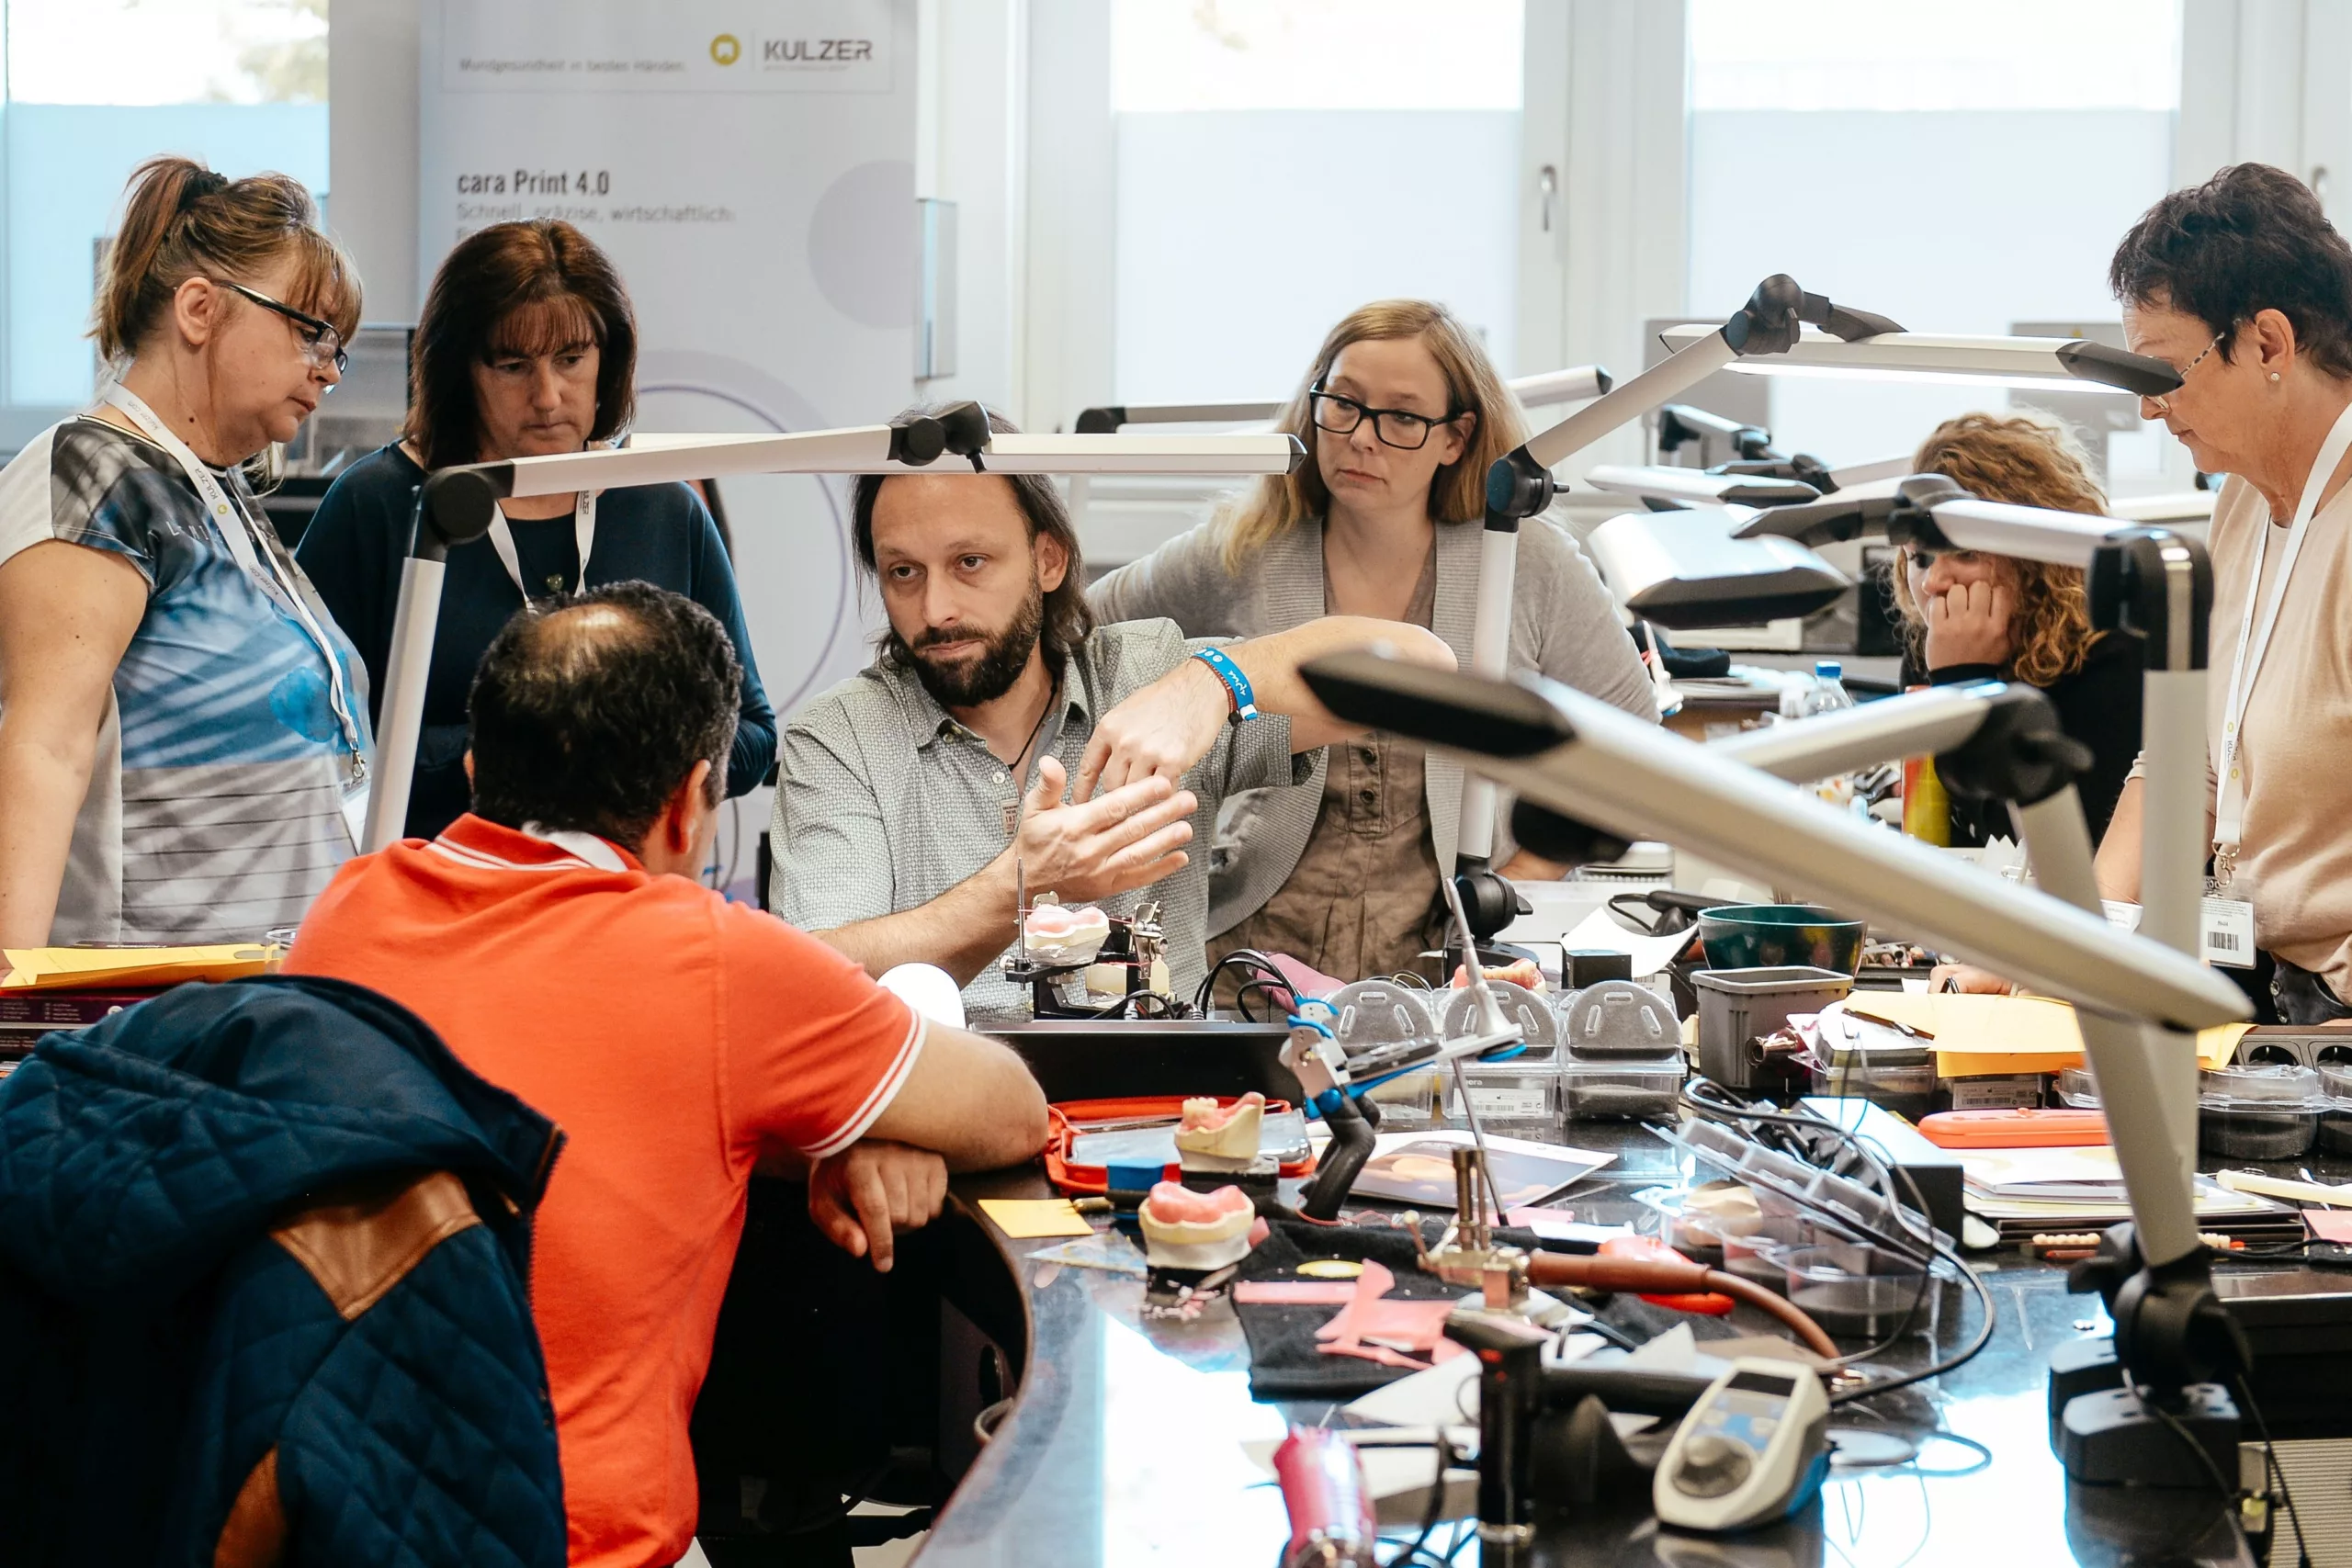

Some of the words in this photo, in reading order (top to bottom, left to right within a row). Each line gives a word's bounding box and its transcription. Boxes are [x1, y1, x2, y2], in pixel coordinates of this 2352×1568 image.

[763, 39, 873, 61] KULZER
[458, 173, 506, 195] cara
[514, 169, 567, 195] Print
[576, 171, 610, 195] 4.0
[194, 468, 219, 500] KULZER
